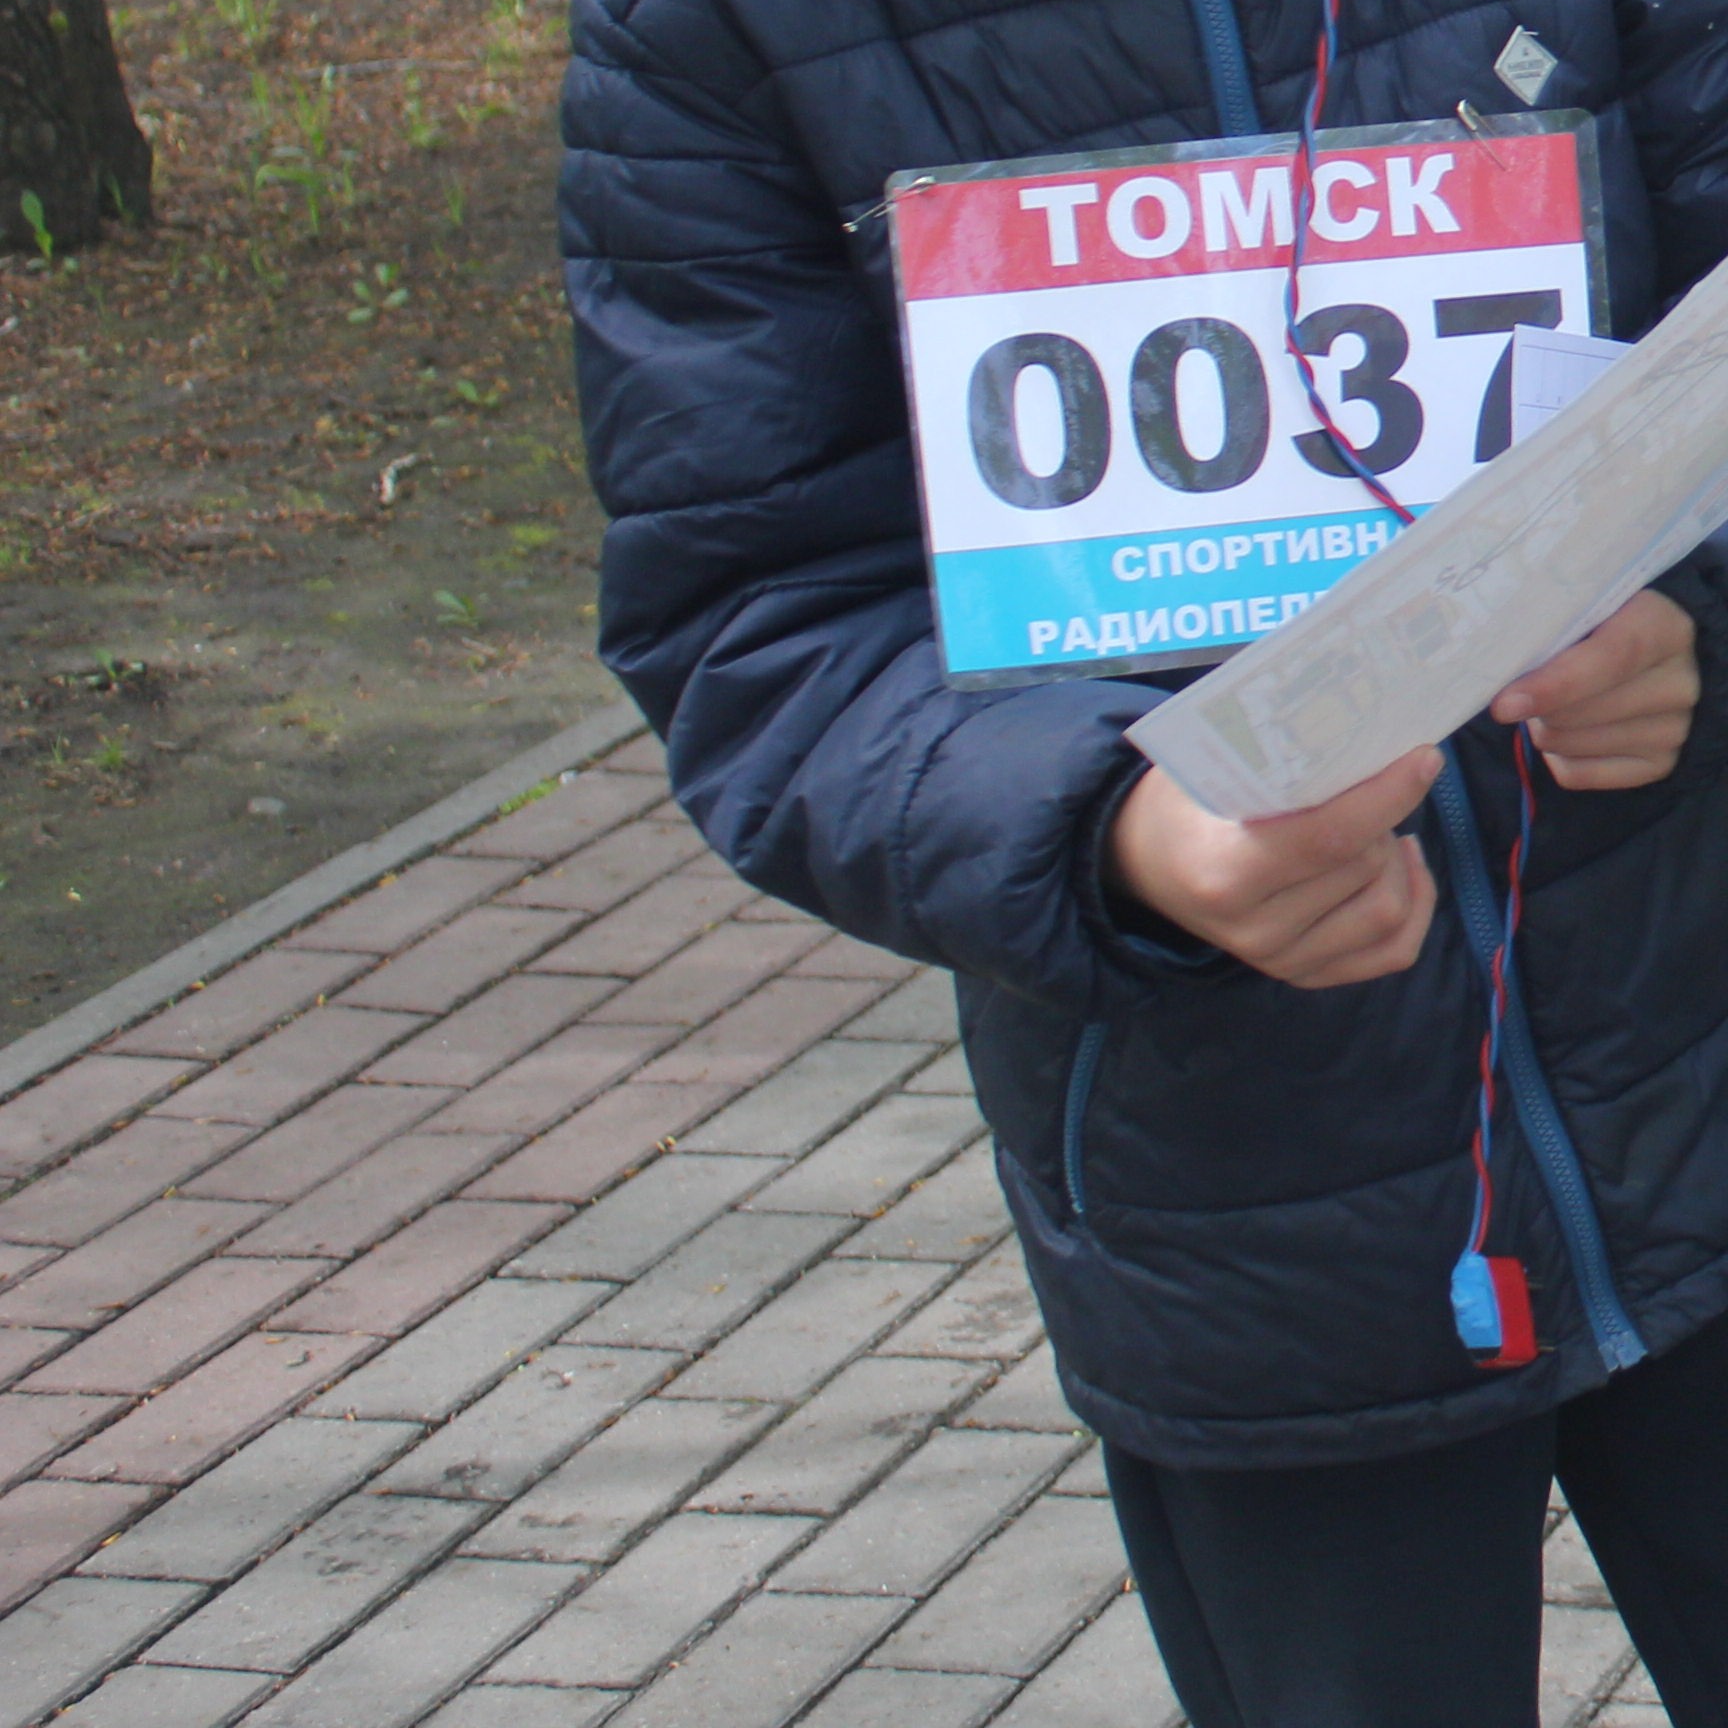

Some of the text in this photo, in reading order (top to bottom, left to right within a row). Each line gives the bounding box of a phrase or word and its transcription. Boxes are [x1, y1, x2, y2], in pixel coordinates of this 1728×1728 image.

[1018, 152, 1462, 267] ТОМСК
[967, 289, 1564, 511] 0037
[1111, 519, 1405, 583] СПОРТИВН
[1027, 588, 1330, 656] РАДИОПЕЛ
